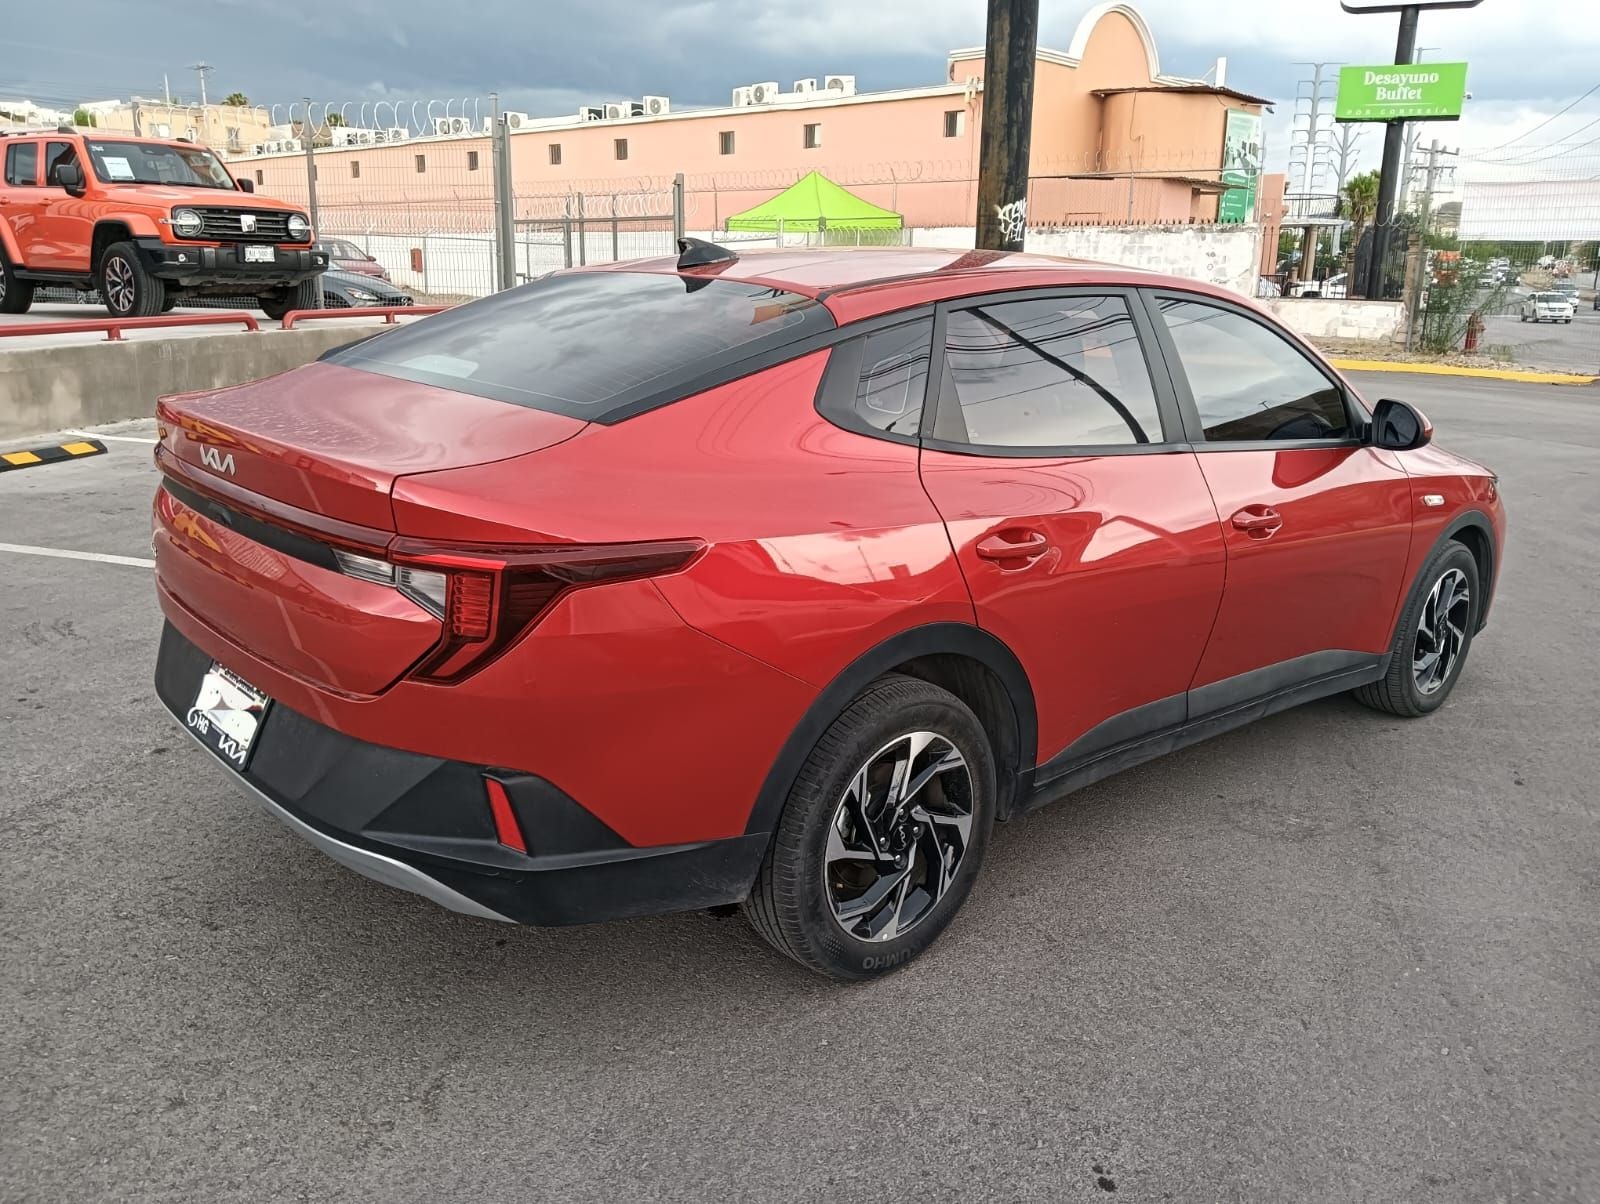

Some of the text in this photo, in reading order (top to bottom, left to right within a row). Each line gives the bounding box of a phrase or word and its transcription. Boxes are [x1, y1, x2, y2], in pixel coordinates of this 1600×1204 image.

[1364, 71, 1440, 87] Desayuno
[1376, 86, 1422, 100] Buffet
[200, 443, 236, 476] KIA
[218, 734, 247, 765] KIA
